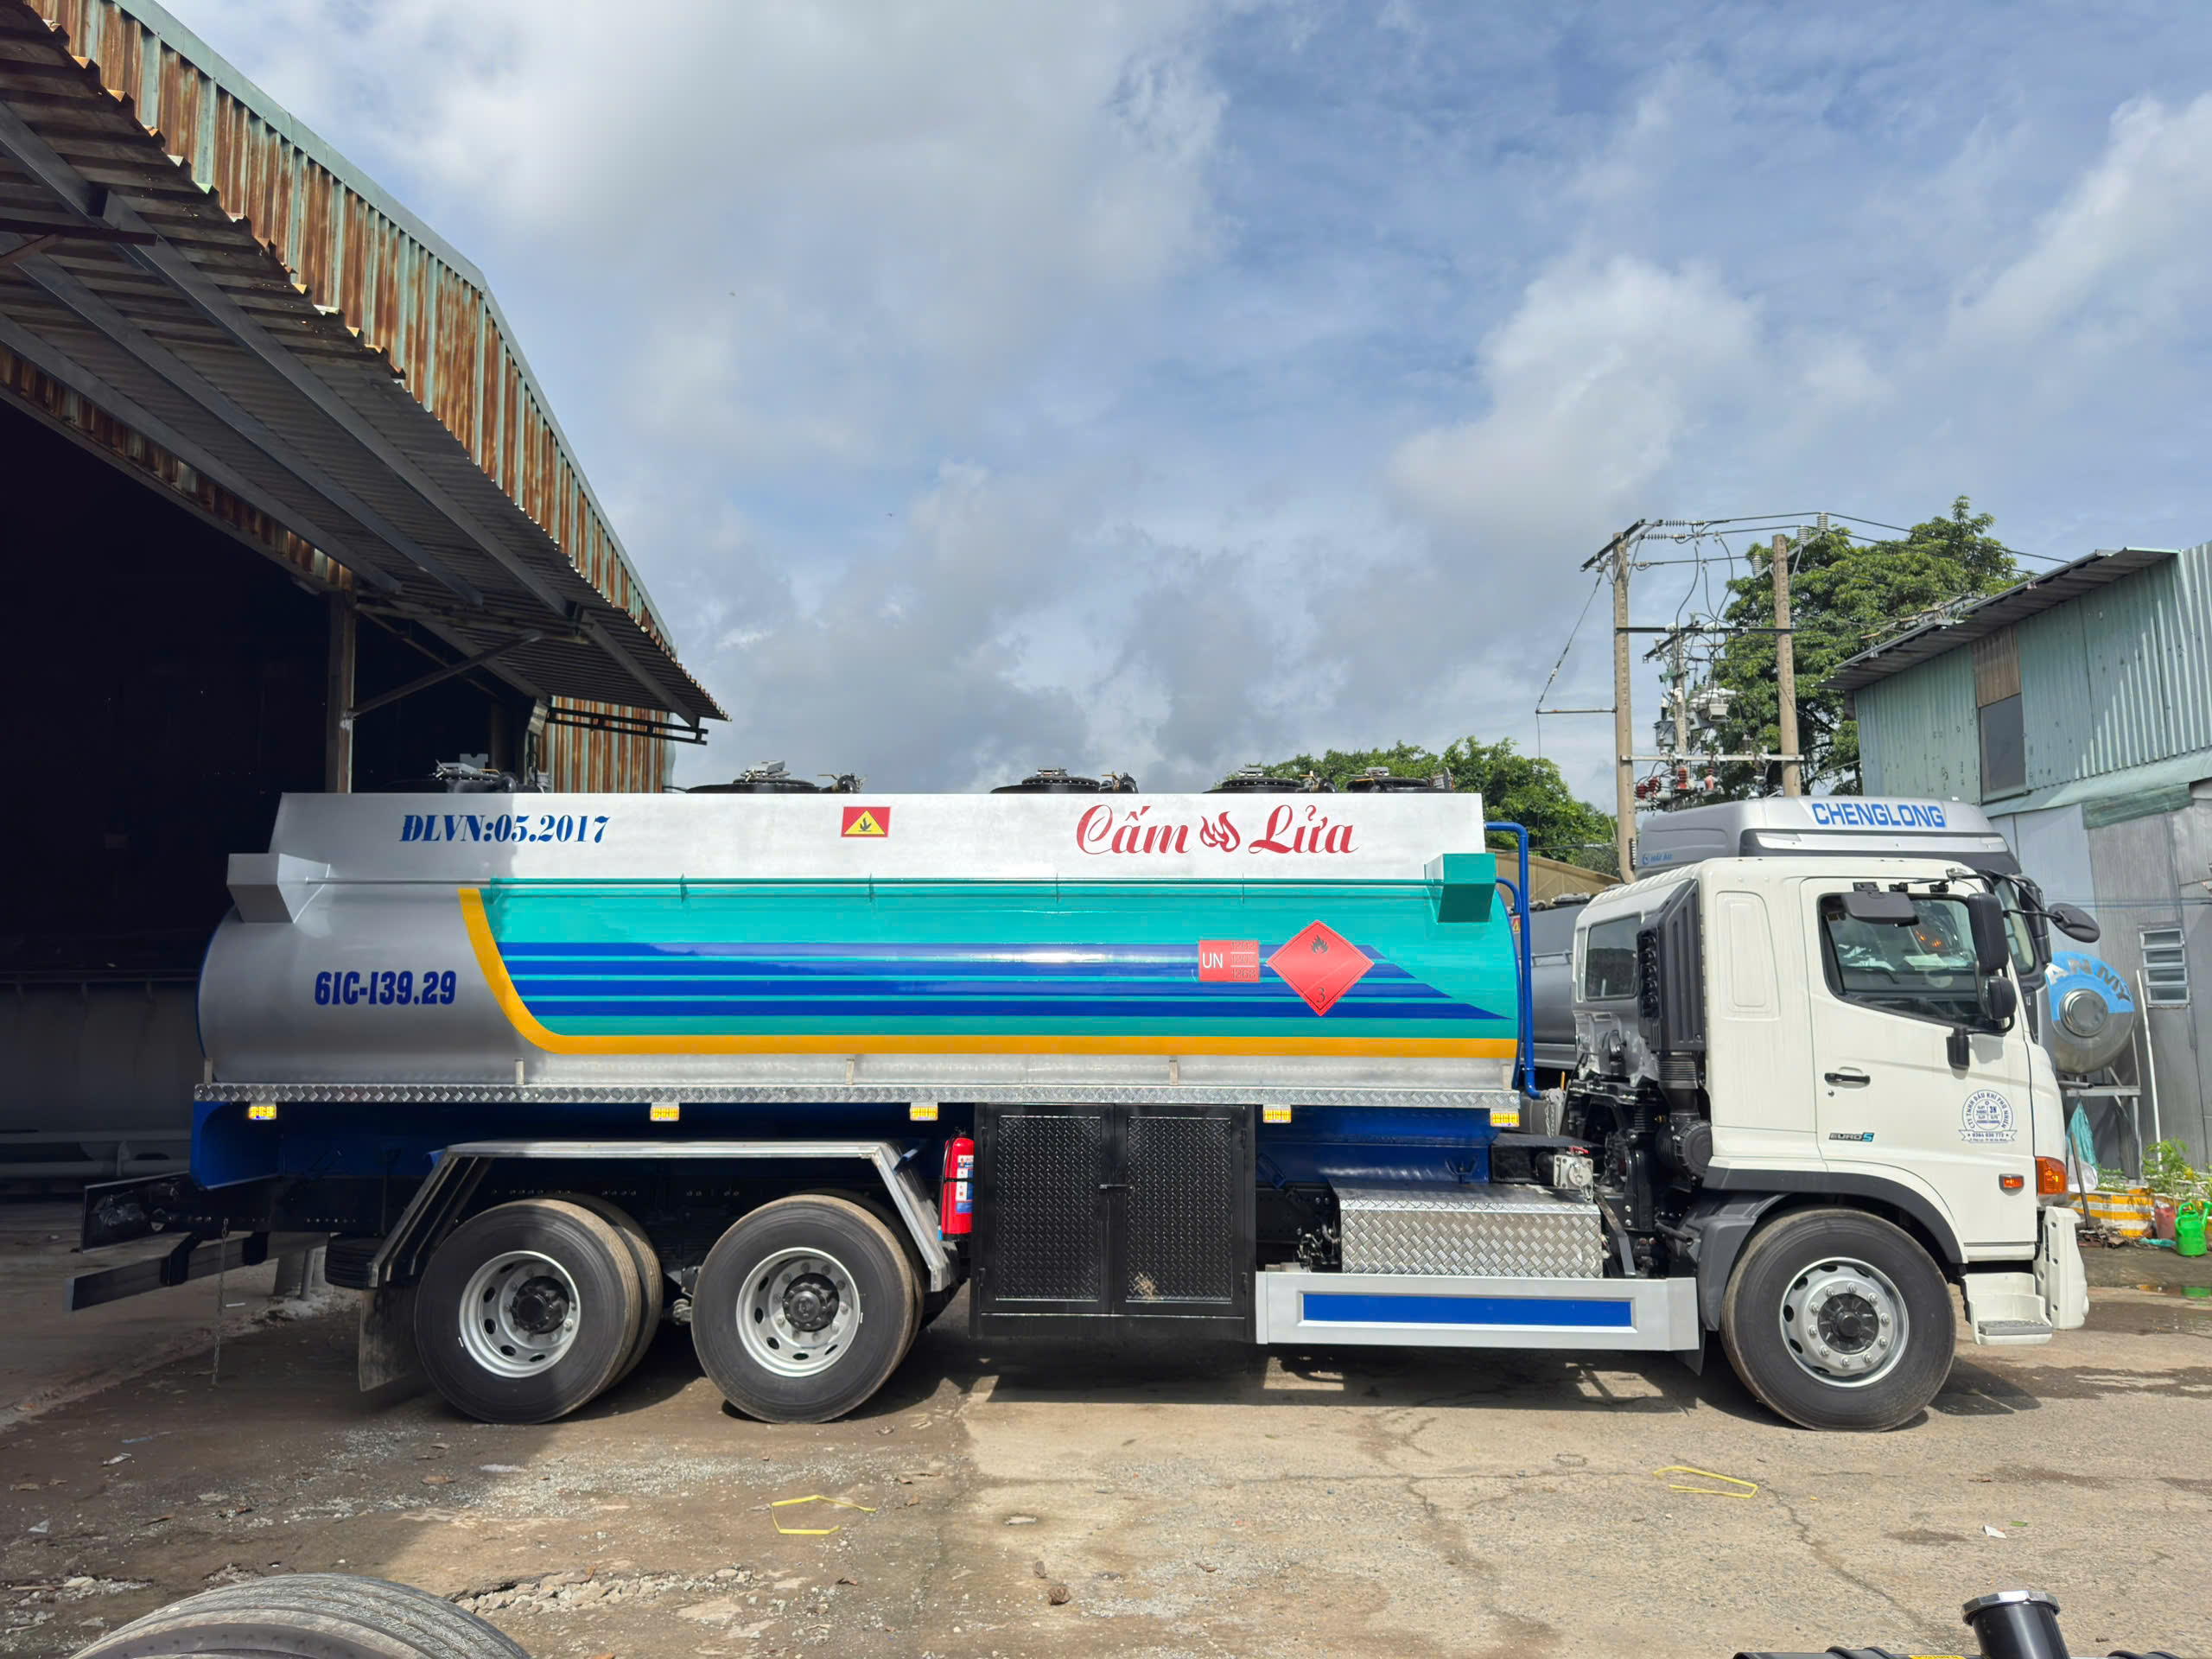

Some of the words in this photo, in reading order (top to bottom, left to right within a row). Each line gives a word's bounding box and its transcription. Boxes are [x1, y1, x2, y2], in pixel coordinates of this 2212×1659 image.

[1812, 803, 1946, 828] CHENGLONG
[1076, 804, 1193, 855] Cấm
[1249, 804, 1362, 854] Lửa
[1202, 952, 1224, 969] UN
[1230, 969, 1256, 981] 1268
[315, 970, 456, 1005] 61C-139.29
[1316, 988, 1325, 1003] 3
